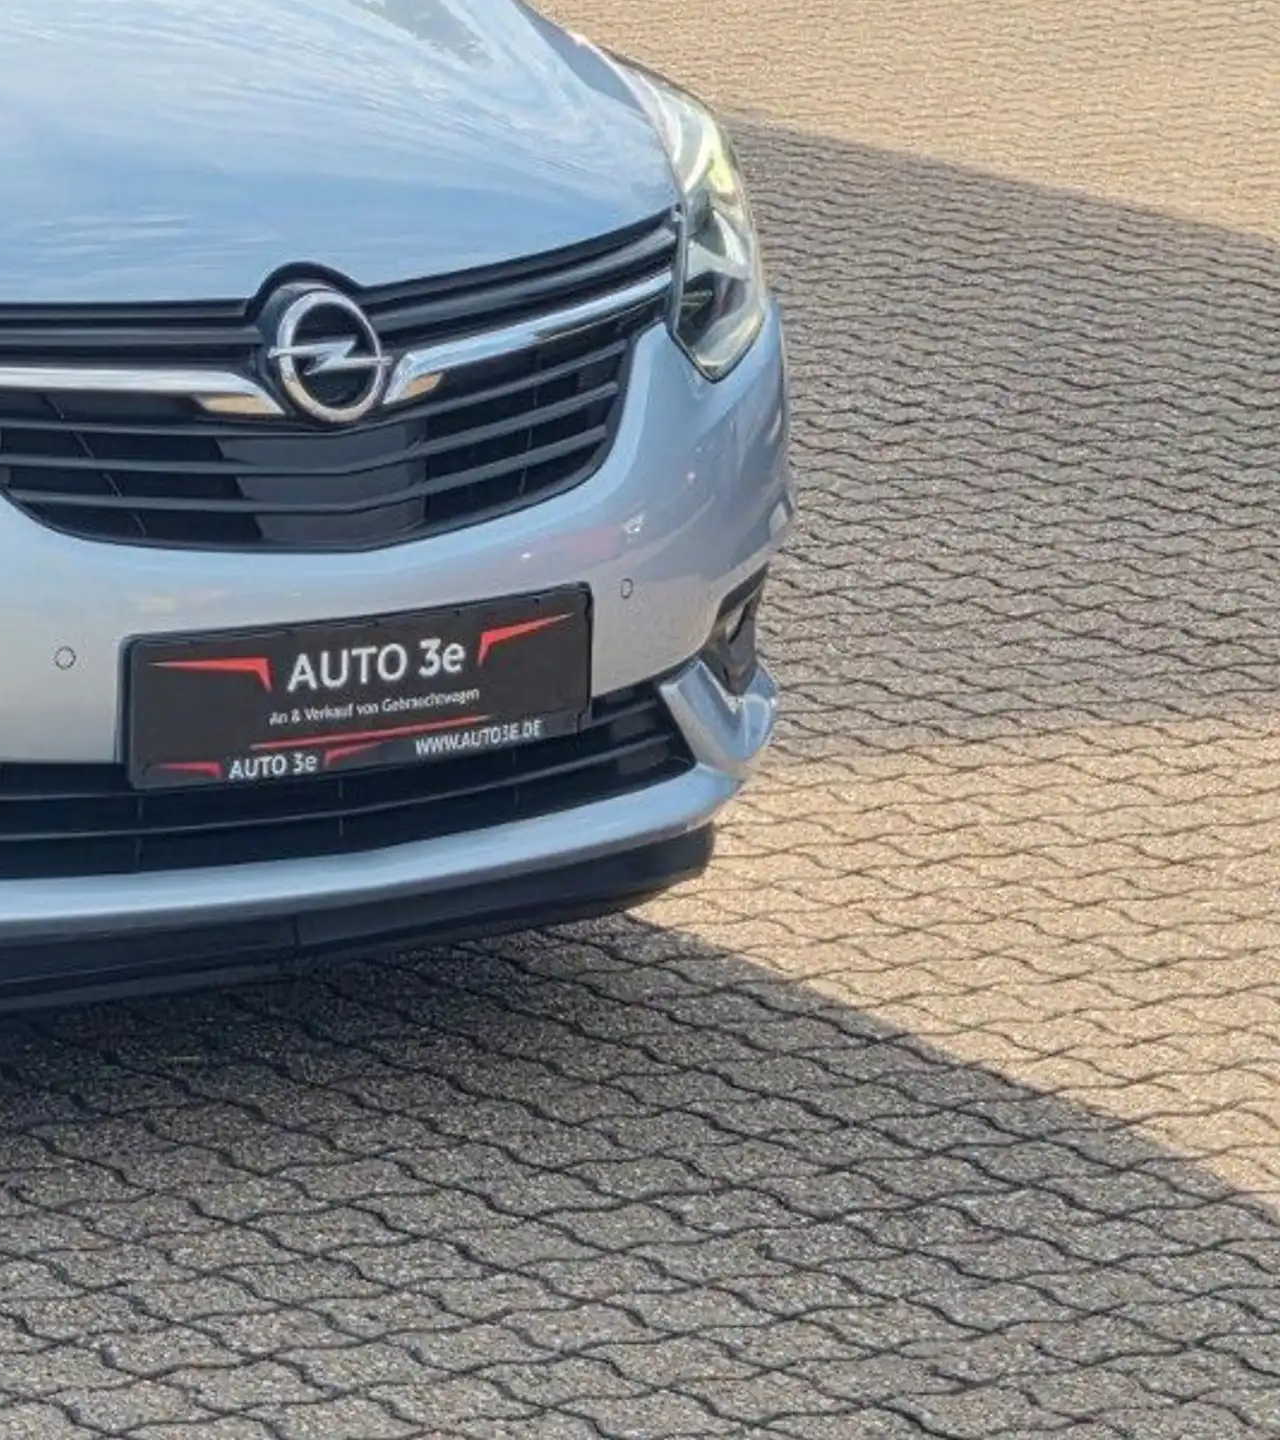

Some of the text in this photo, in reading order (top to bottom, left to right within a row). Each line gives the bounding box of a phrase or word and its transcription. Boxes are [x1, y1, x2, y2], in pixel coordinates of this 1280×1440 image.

[287, 637, 466, 692] AUTO 3e
[269, 687, 480, 726] An & Verkauf von Gebrauchtwagen
[415, 719, 543, 756] WWW.AUTO3E.DE
[228, 751, 319, 780] AUTO 3e
